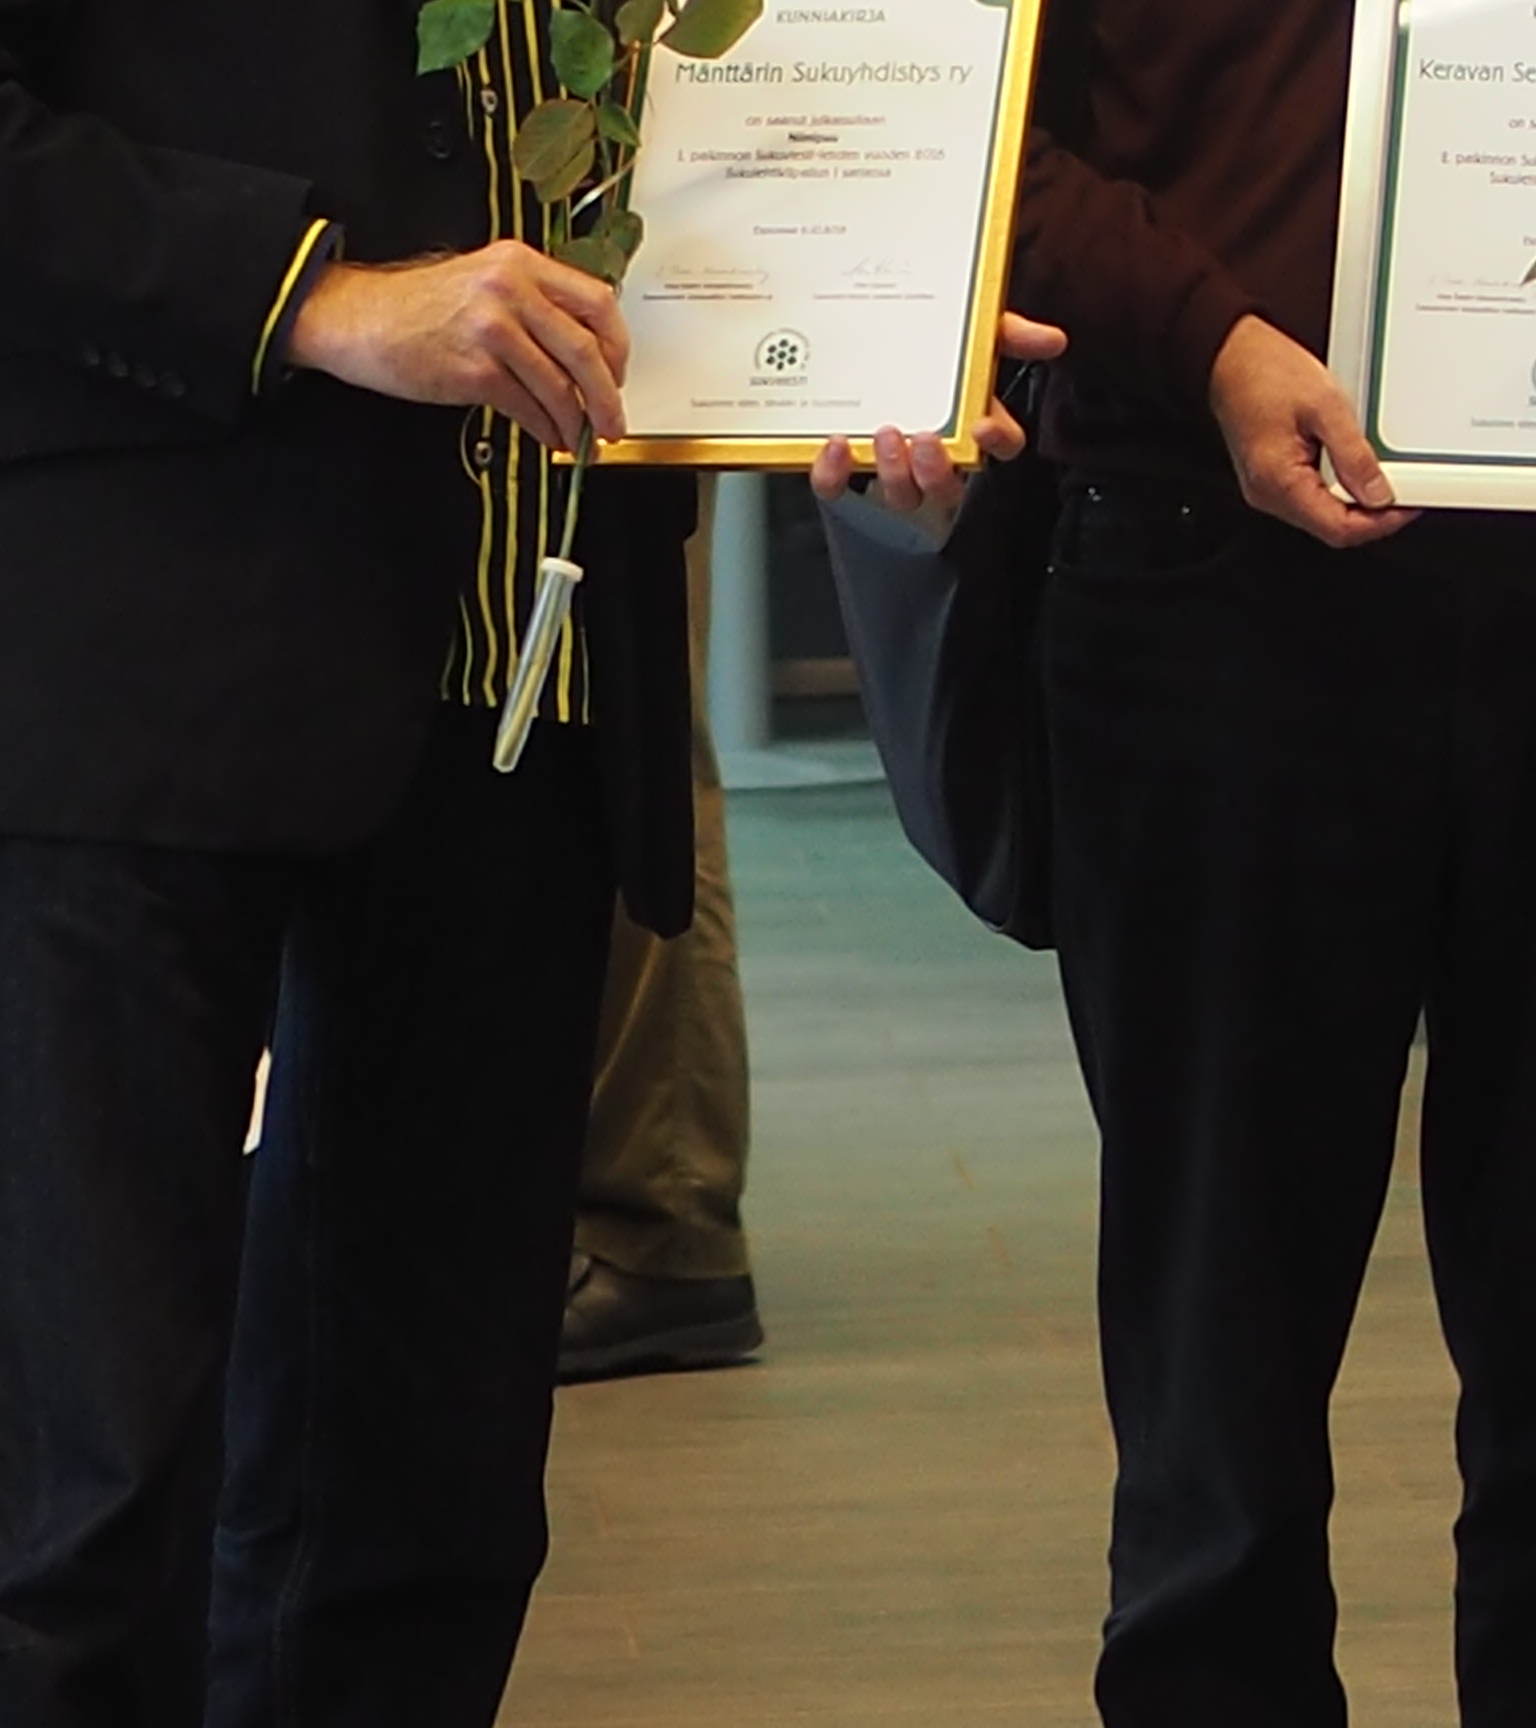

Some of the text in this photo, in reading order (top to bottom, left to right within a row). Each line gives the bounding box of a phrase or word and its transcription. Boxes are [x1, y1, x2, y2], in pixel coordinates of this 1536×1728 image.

[776, 9, 886, 24] KUNNIAKIRJA
[674, 61, 973, 86] Mänttärin Sukuyhdistys ry
[1418, 58, 1504, 83] Keravan
